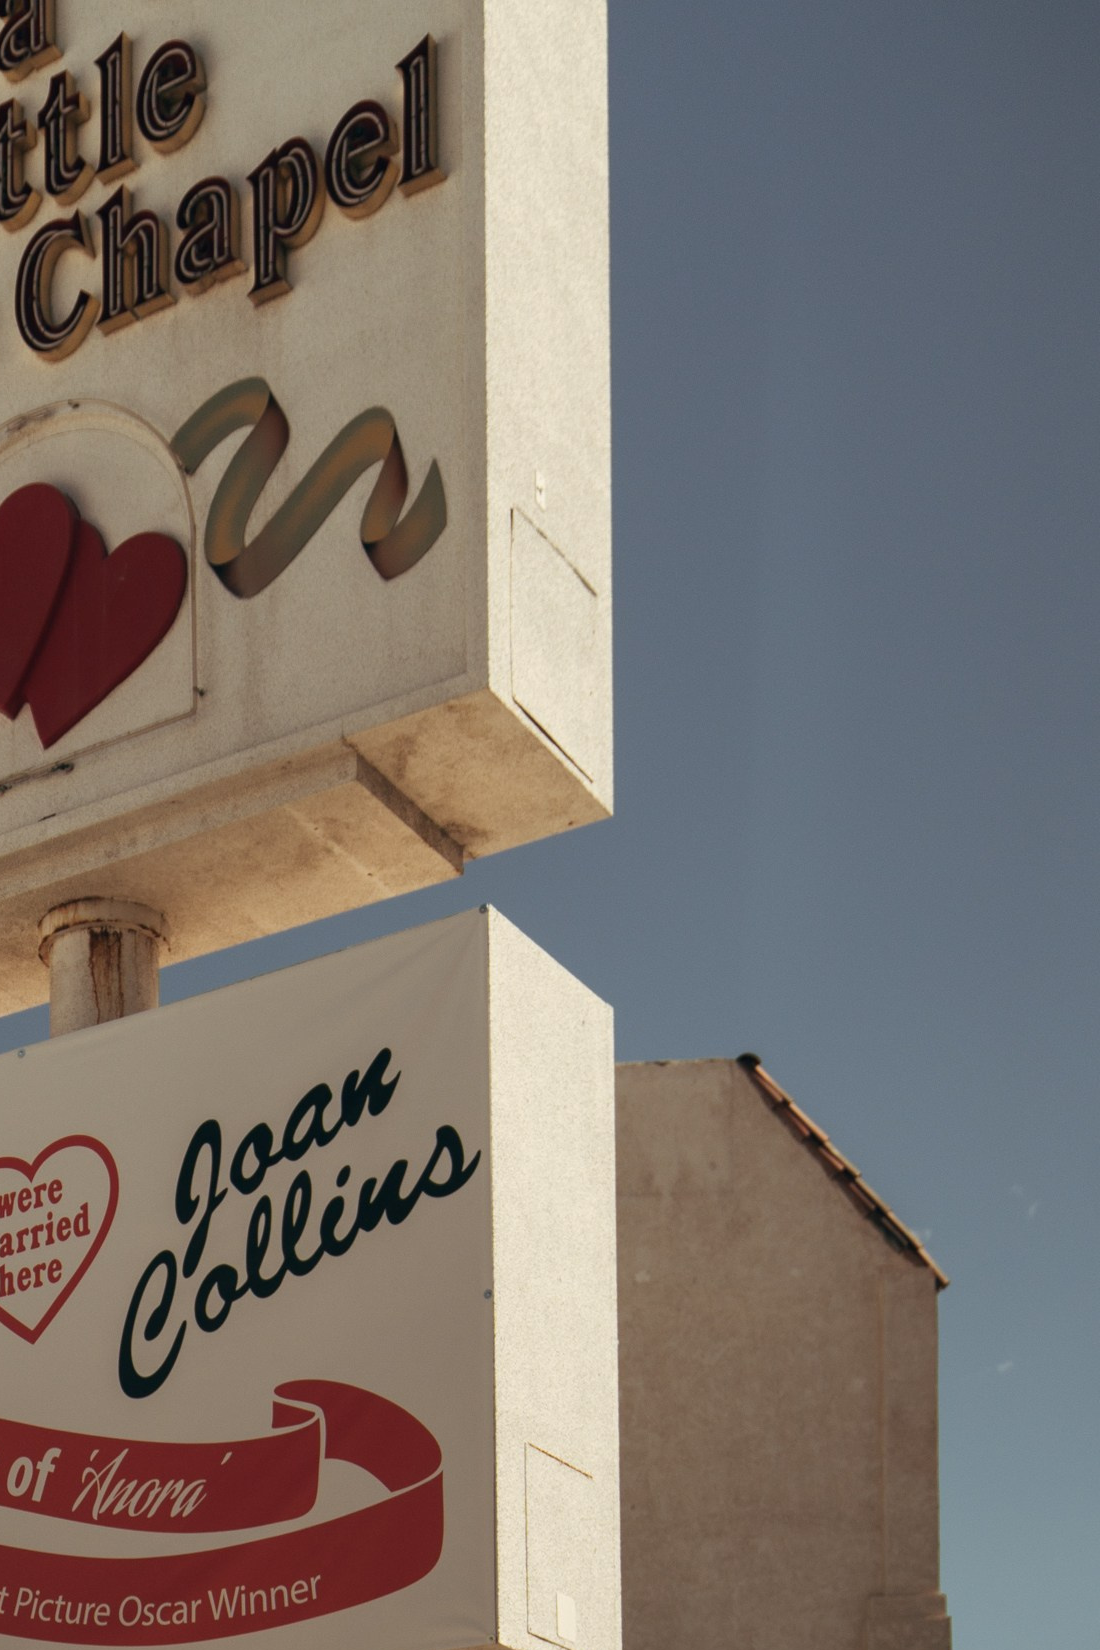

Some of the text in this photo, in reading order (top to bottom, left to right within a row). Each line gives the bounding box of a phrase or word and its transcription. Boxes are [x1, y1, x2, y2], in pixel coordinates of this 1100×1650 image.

[13, 32, 447, 361] Chapel
[117, 1124, 480, 1400] Collins
[175, 1046, 402, 1275] Joan
[6, 1447, 60, 1504] of
[12, 1585, 111, 1628] Picture
[117, 1596, 201, 1629] Oscar
[206, 1573, 322, 1620] Winner
